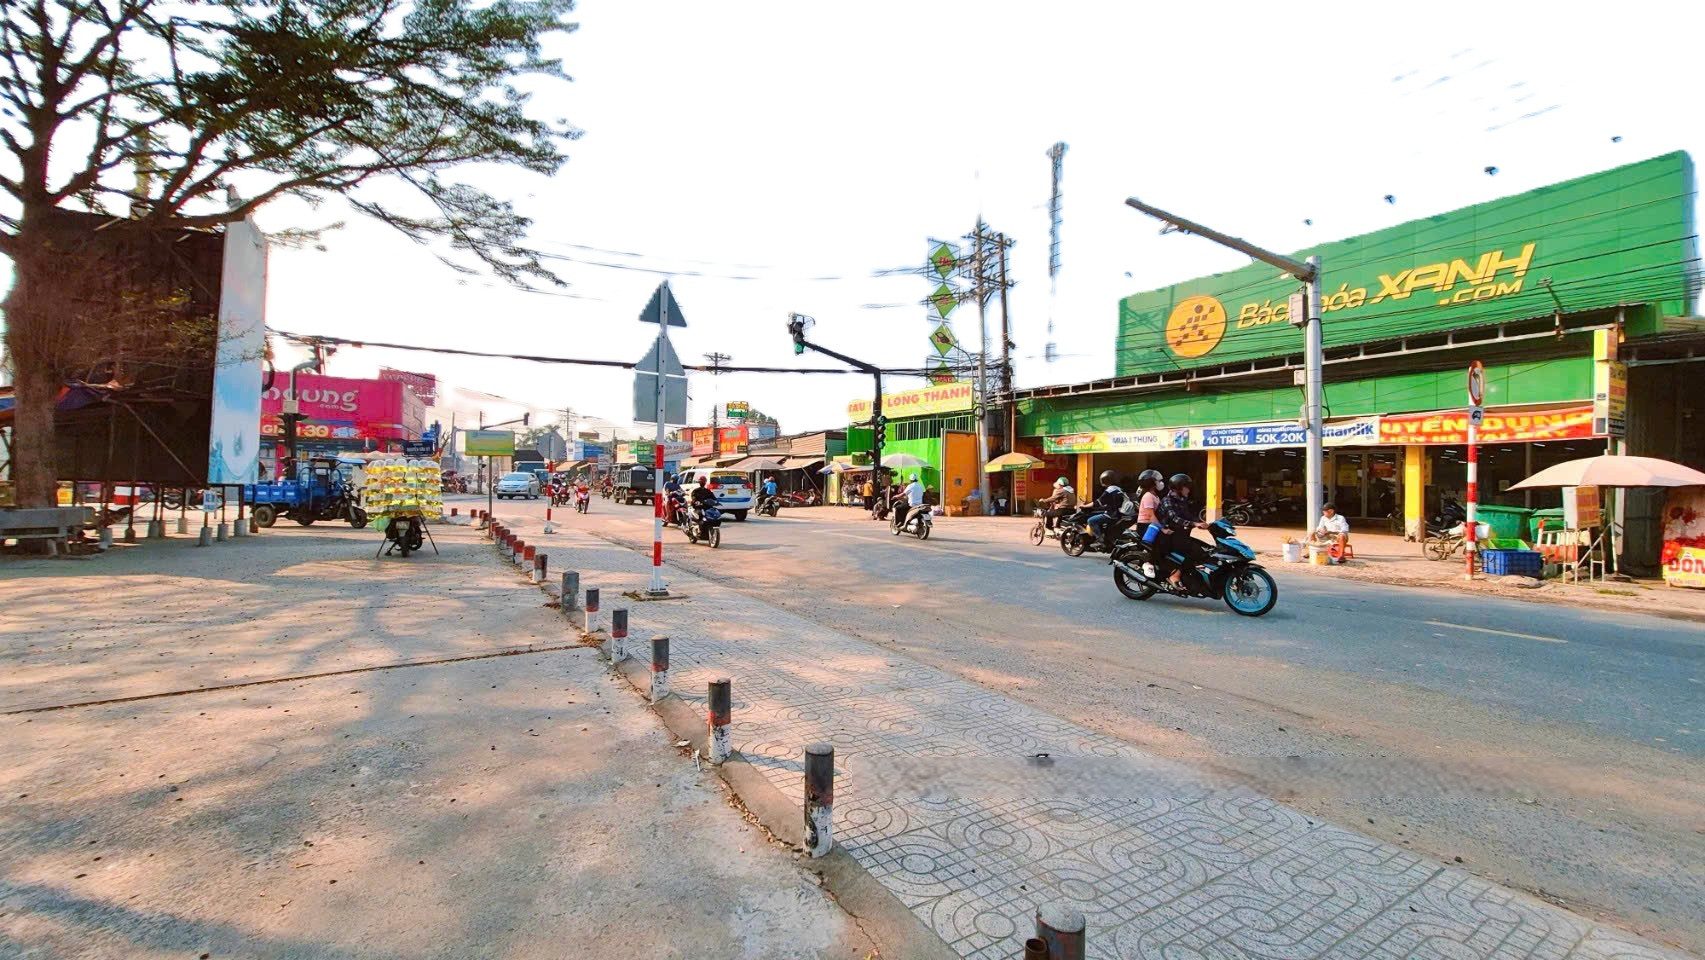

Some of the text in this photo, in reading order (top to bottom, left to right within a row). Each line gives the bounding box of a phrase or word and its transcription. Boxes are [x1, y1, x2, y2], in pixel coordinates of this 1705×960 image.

[1237, 299, 1290, 328] Bác
[1371, 243, 1535, 304] XANH
[1440, 279, 1523, 306] .COM
[887, 394, 920, 408] LONG
[1207, 436, 1219, 445] 10
[1281, 432, 1305, 443] 20K
